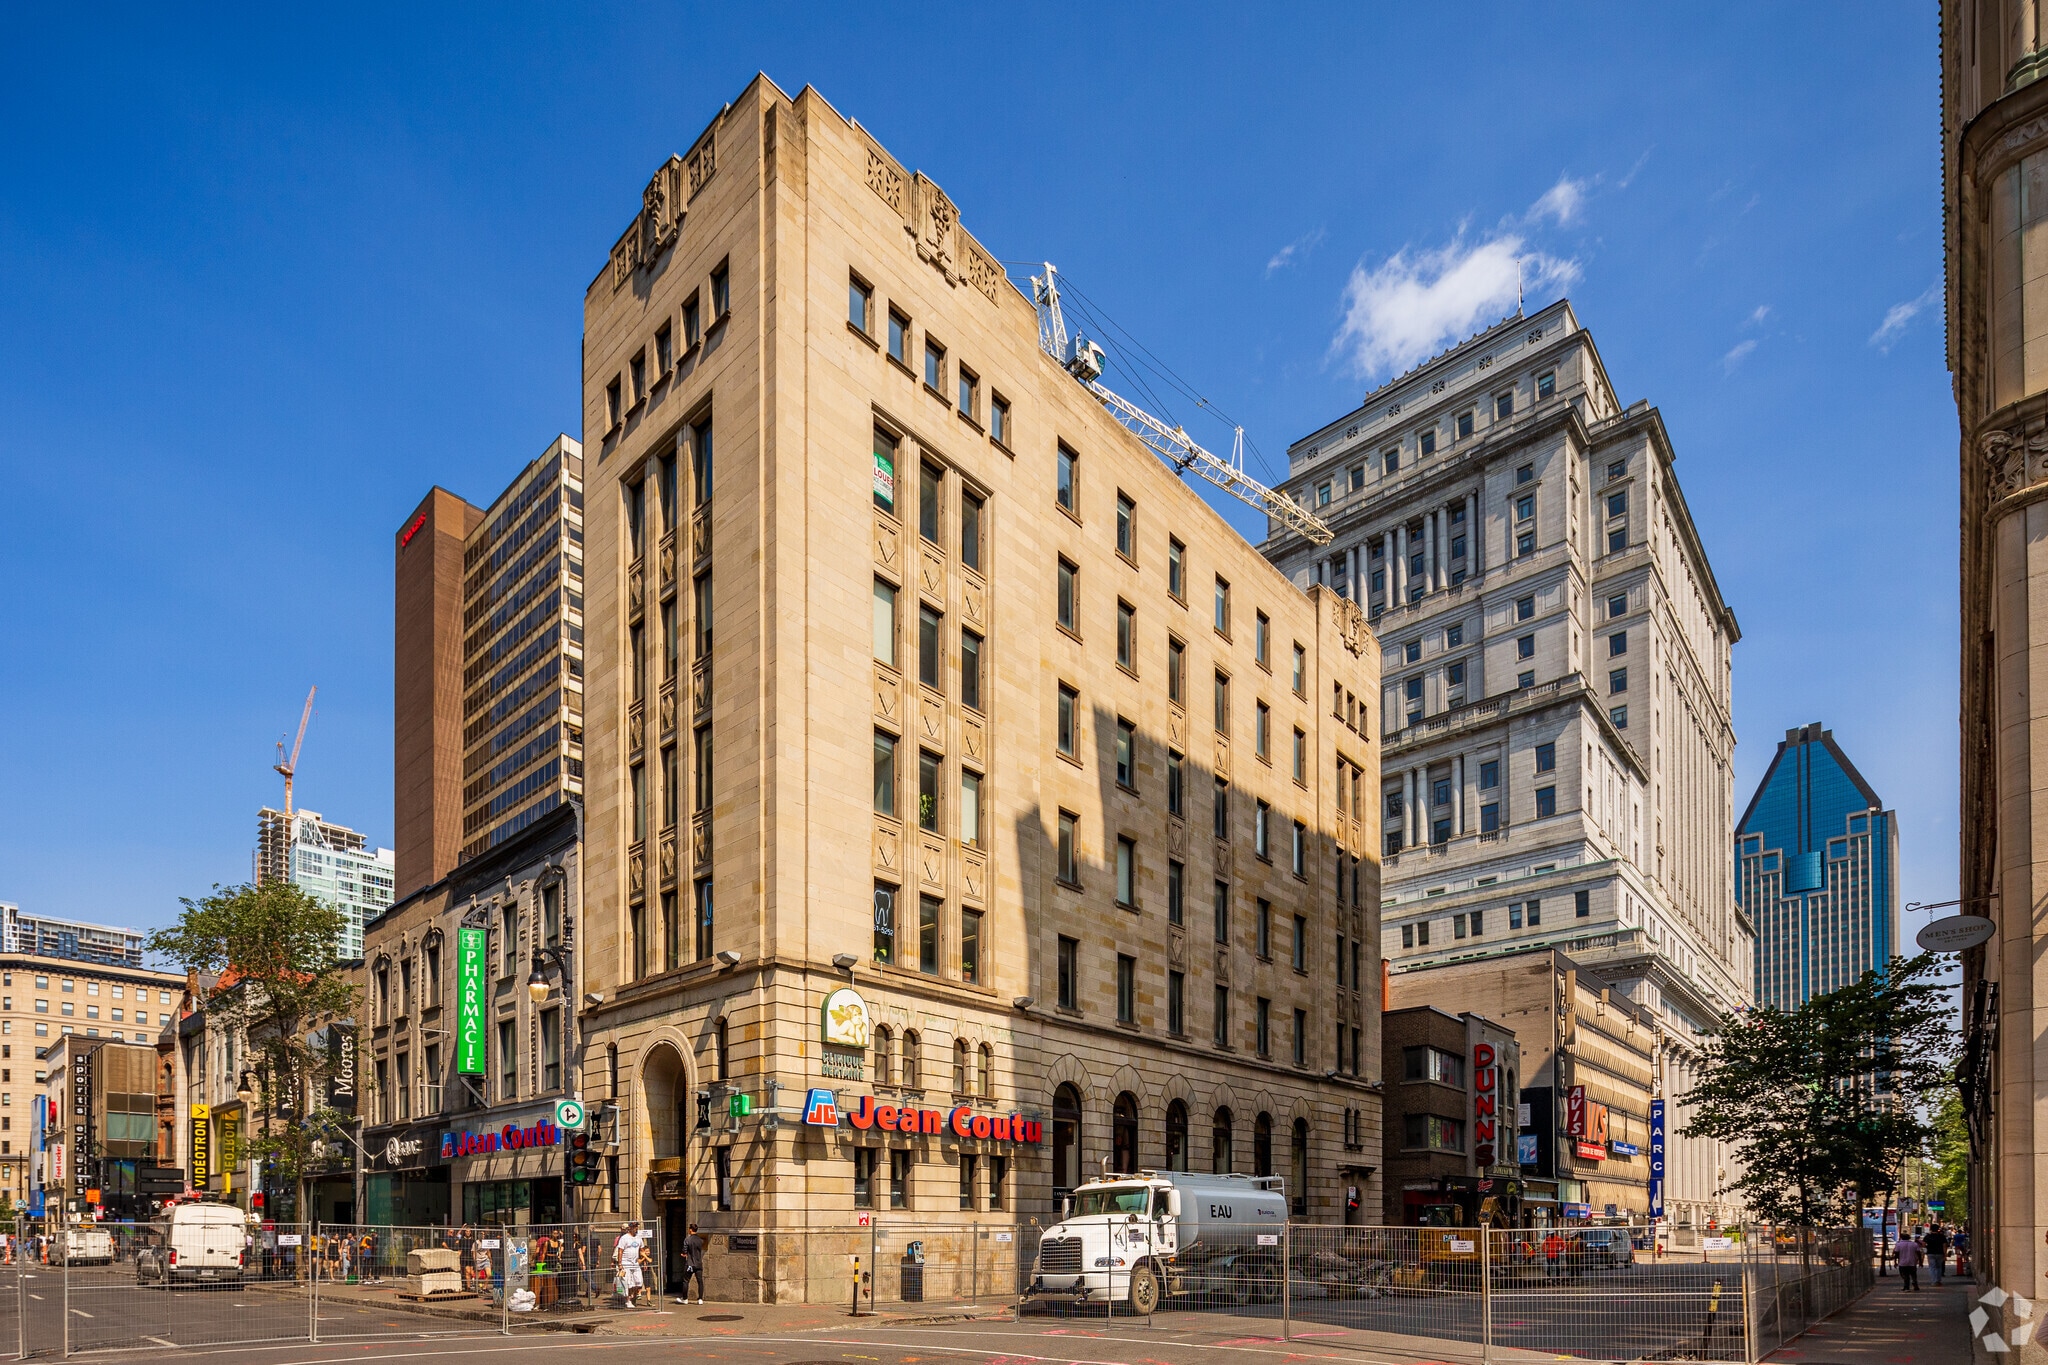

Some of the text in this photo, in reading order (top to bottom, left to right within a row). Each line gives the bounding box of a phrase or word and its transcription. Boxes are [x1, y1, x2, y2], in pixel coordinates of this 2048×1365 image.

[1925, 924, 1987, 939] MEN'S SHOP
[463, 950, 479, 1070] PHARMACIE
[335, 1035, 354, 1097] Moores
[822, 1052, 865, 1067] CLINIQUE
[822, 1064, 865, 1080] DENTAIRE
[76, 1056, 84, 1115] sports
[1474, 1043, 1495, 1167] DUNNS
[848, 1095, 1043, 1143] Jean Coutu
[1571, 1087, 1582, 1134] AVIS
[192, 1120, 207, 1187] VIDÉOTRON
[457, 1130, 499, 1157] Jean
[501, 1119, 561, 1151] Coutu
[1652, 1110, 1663, 1171] PARC
[1210, 1204, 1232, 1218] EAU
